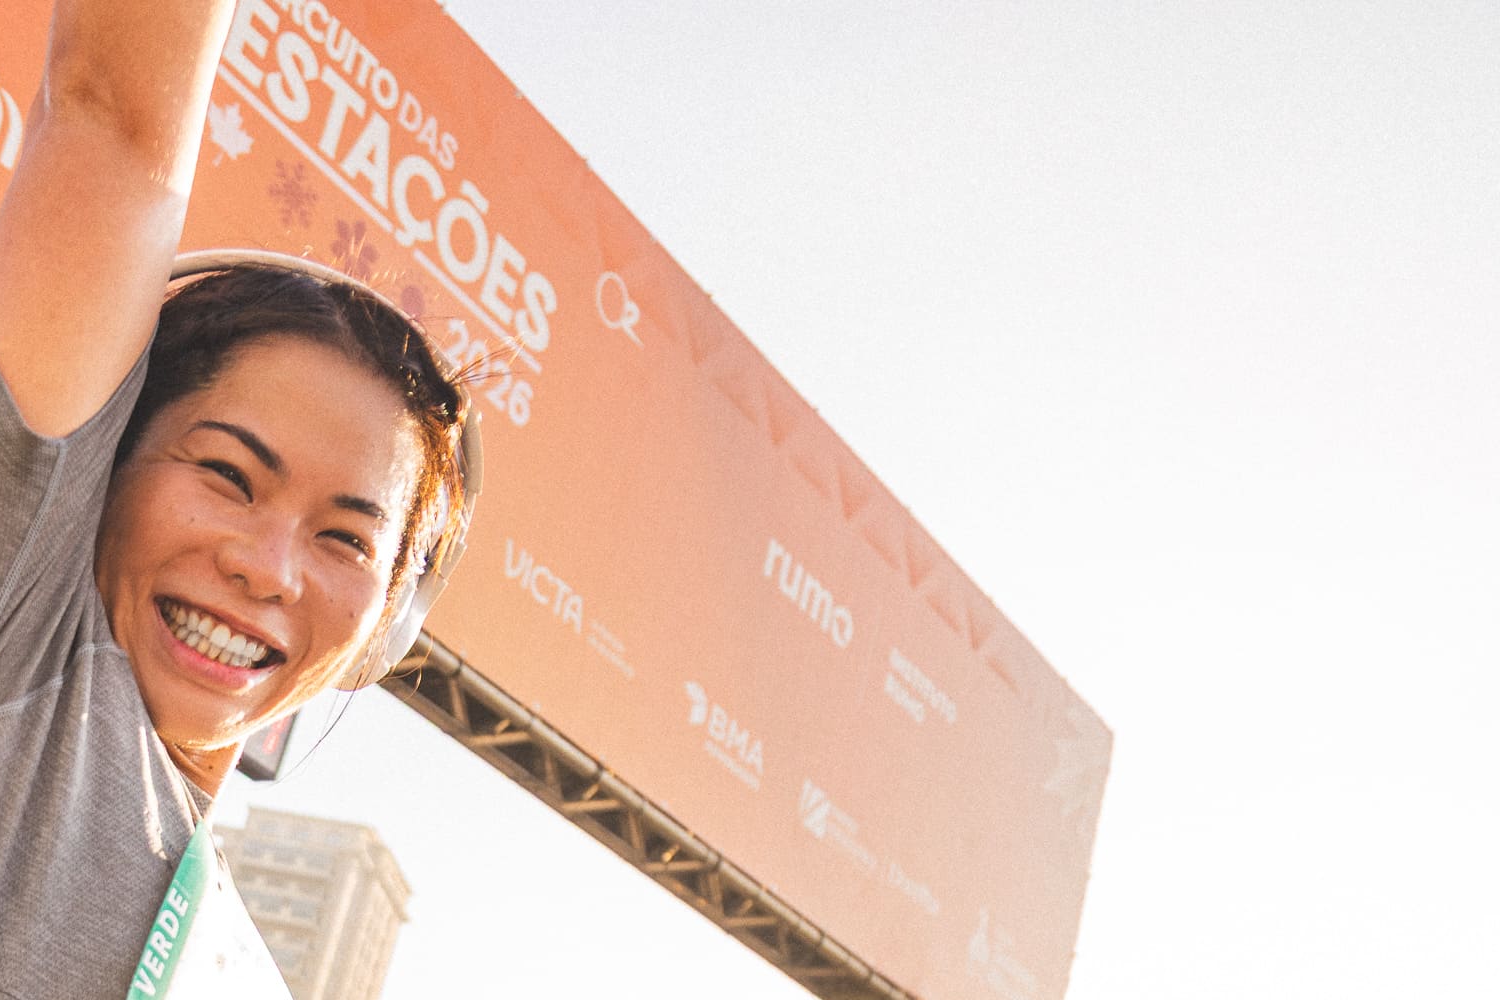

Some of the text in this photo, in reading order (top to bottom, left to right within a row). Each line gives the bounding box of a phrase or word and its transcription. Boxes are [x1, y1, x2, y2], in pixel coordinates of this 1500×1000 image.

[222, 0, 557, 353] ESTAÇÕES
[397, 91, 459, 171] DAS
[446, 318, 534, 427] 2026
[504, 539, 583, 635] VICTA
[763, 538, 855, 649] rumo
[707, 706, 765, 771] BMA
[134, 886, 189, 997] VERDE
